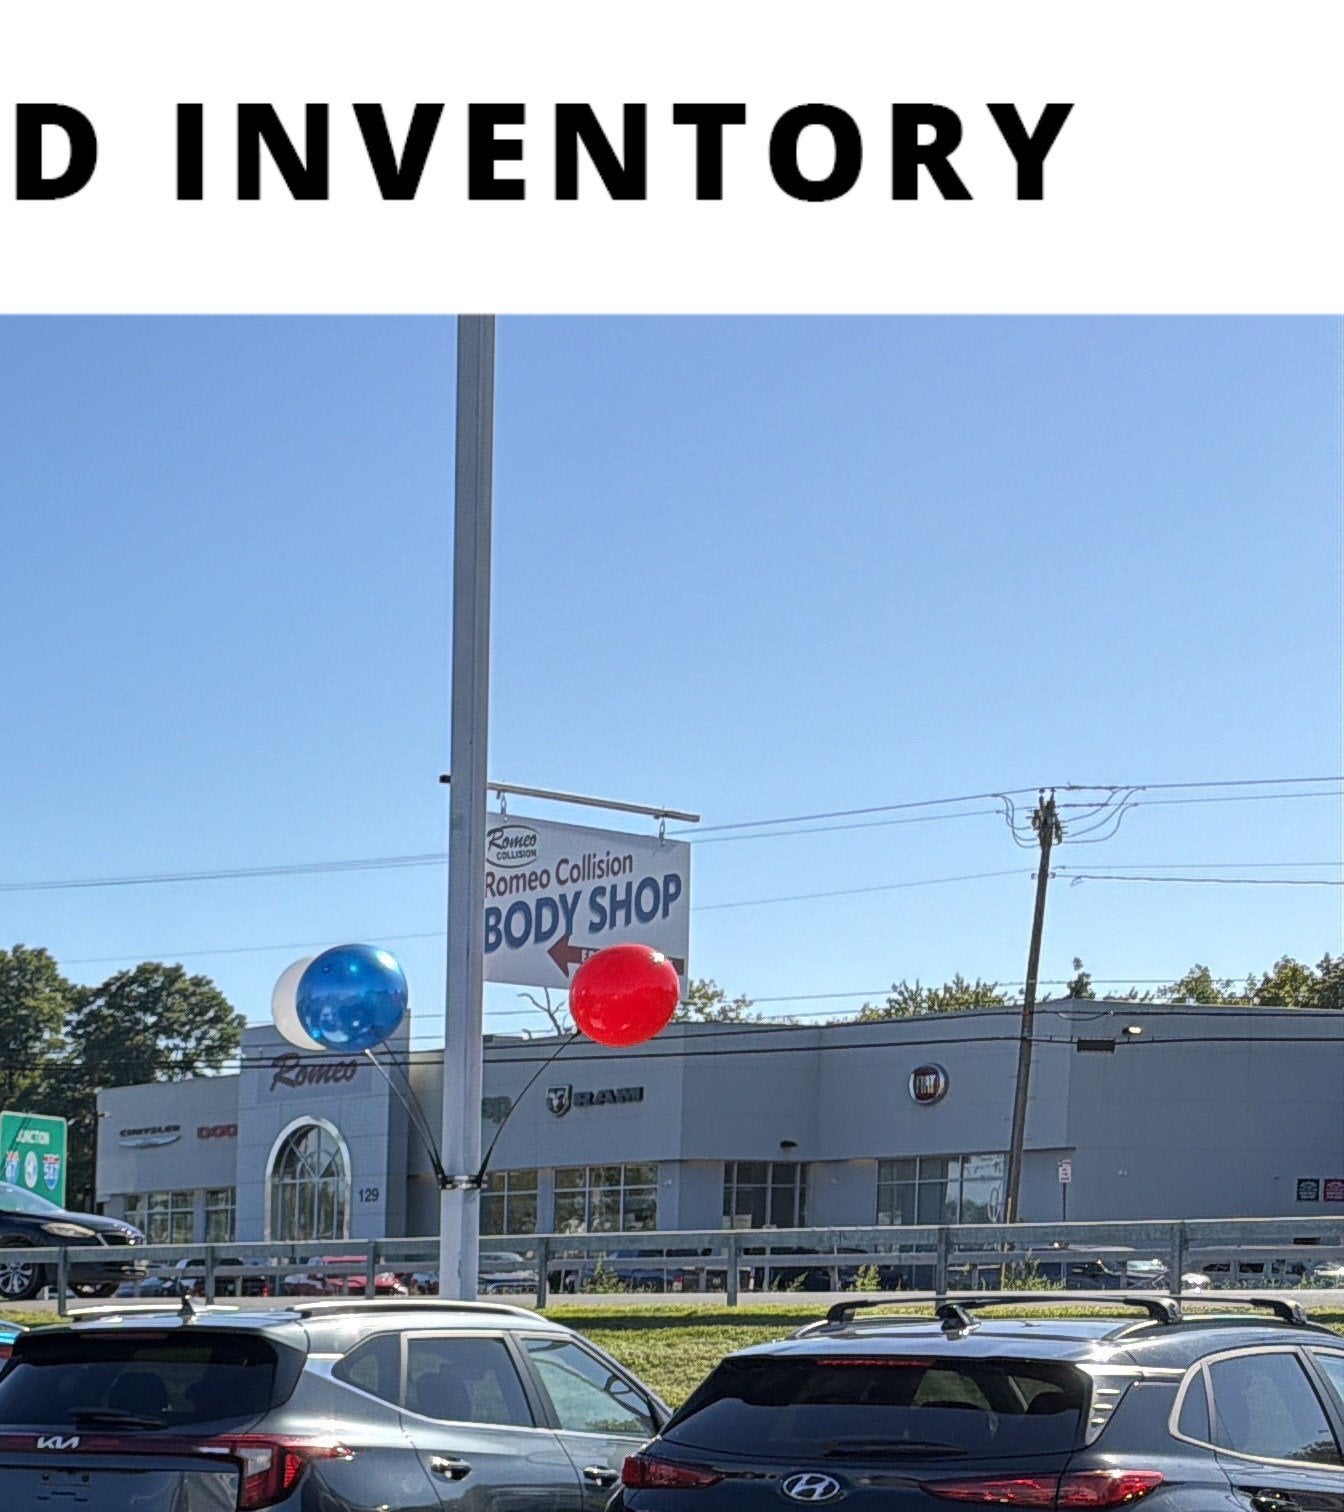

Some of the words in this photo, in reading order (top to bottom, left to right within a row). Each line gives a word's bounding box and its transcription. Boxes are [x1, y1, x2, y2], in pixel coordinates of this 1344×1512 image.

[487, 828, 537, 852] Romeo
[496, 849, 537, 860] COLLISION
[485, 868, 550, 898] Romeo
[556, 851, 633, 887] Collision
[484, 891, 582, 953] BODY
[588, 873, 682, 935] SHOP
[270, 1052, 358, 1091] Romeo
[573, 1086, 645, 1107] RAM
[359, 1187, 379, 1203] 129
